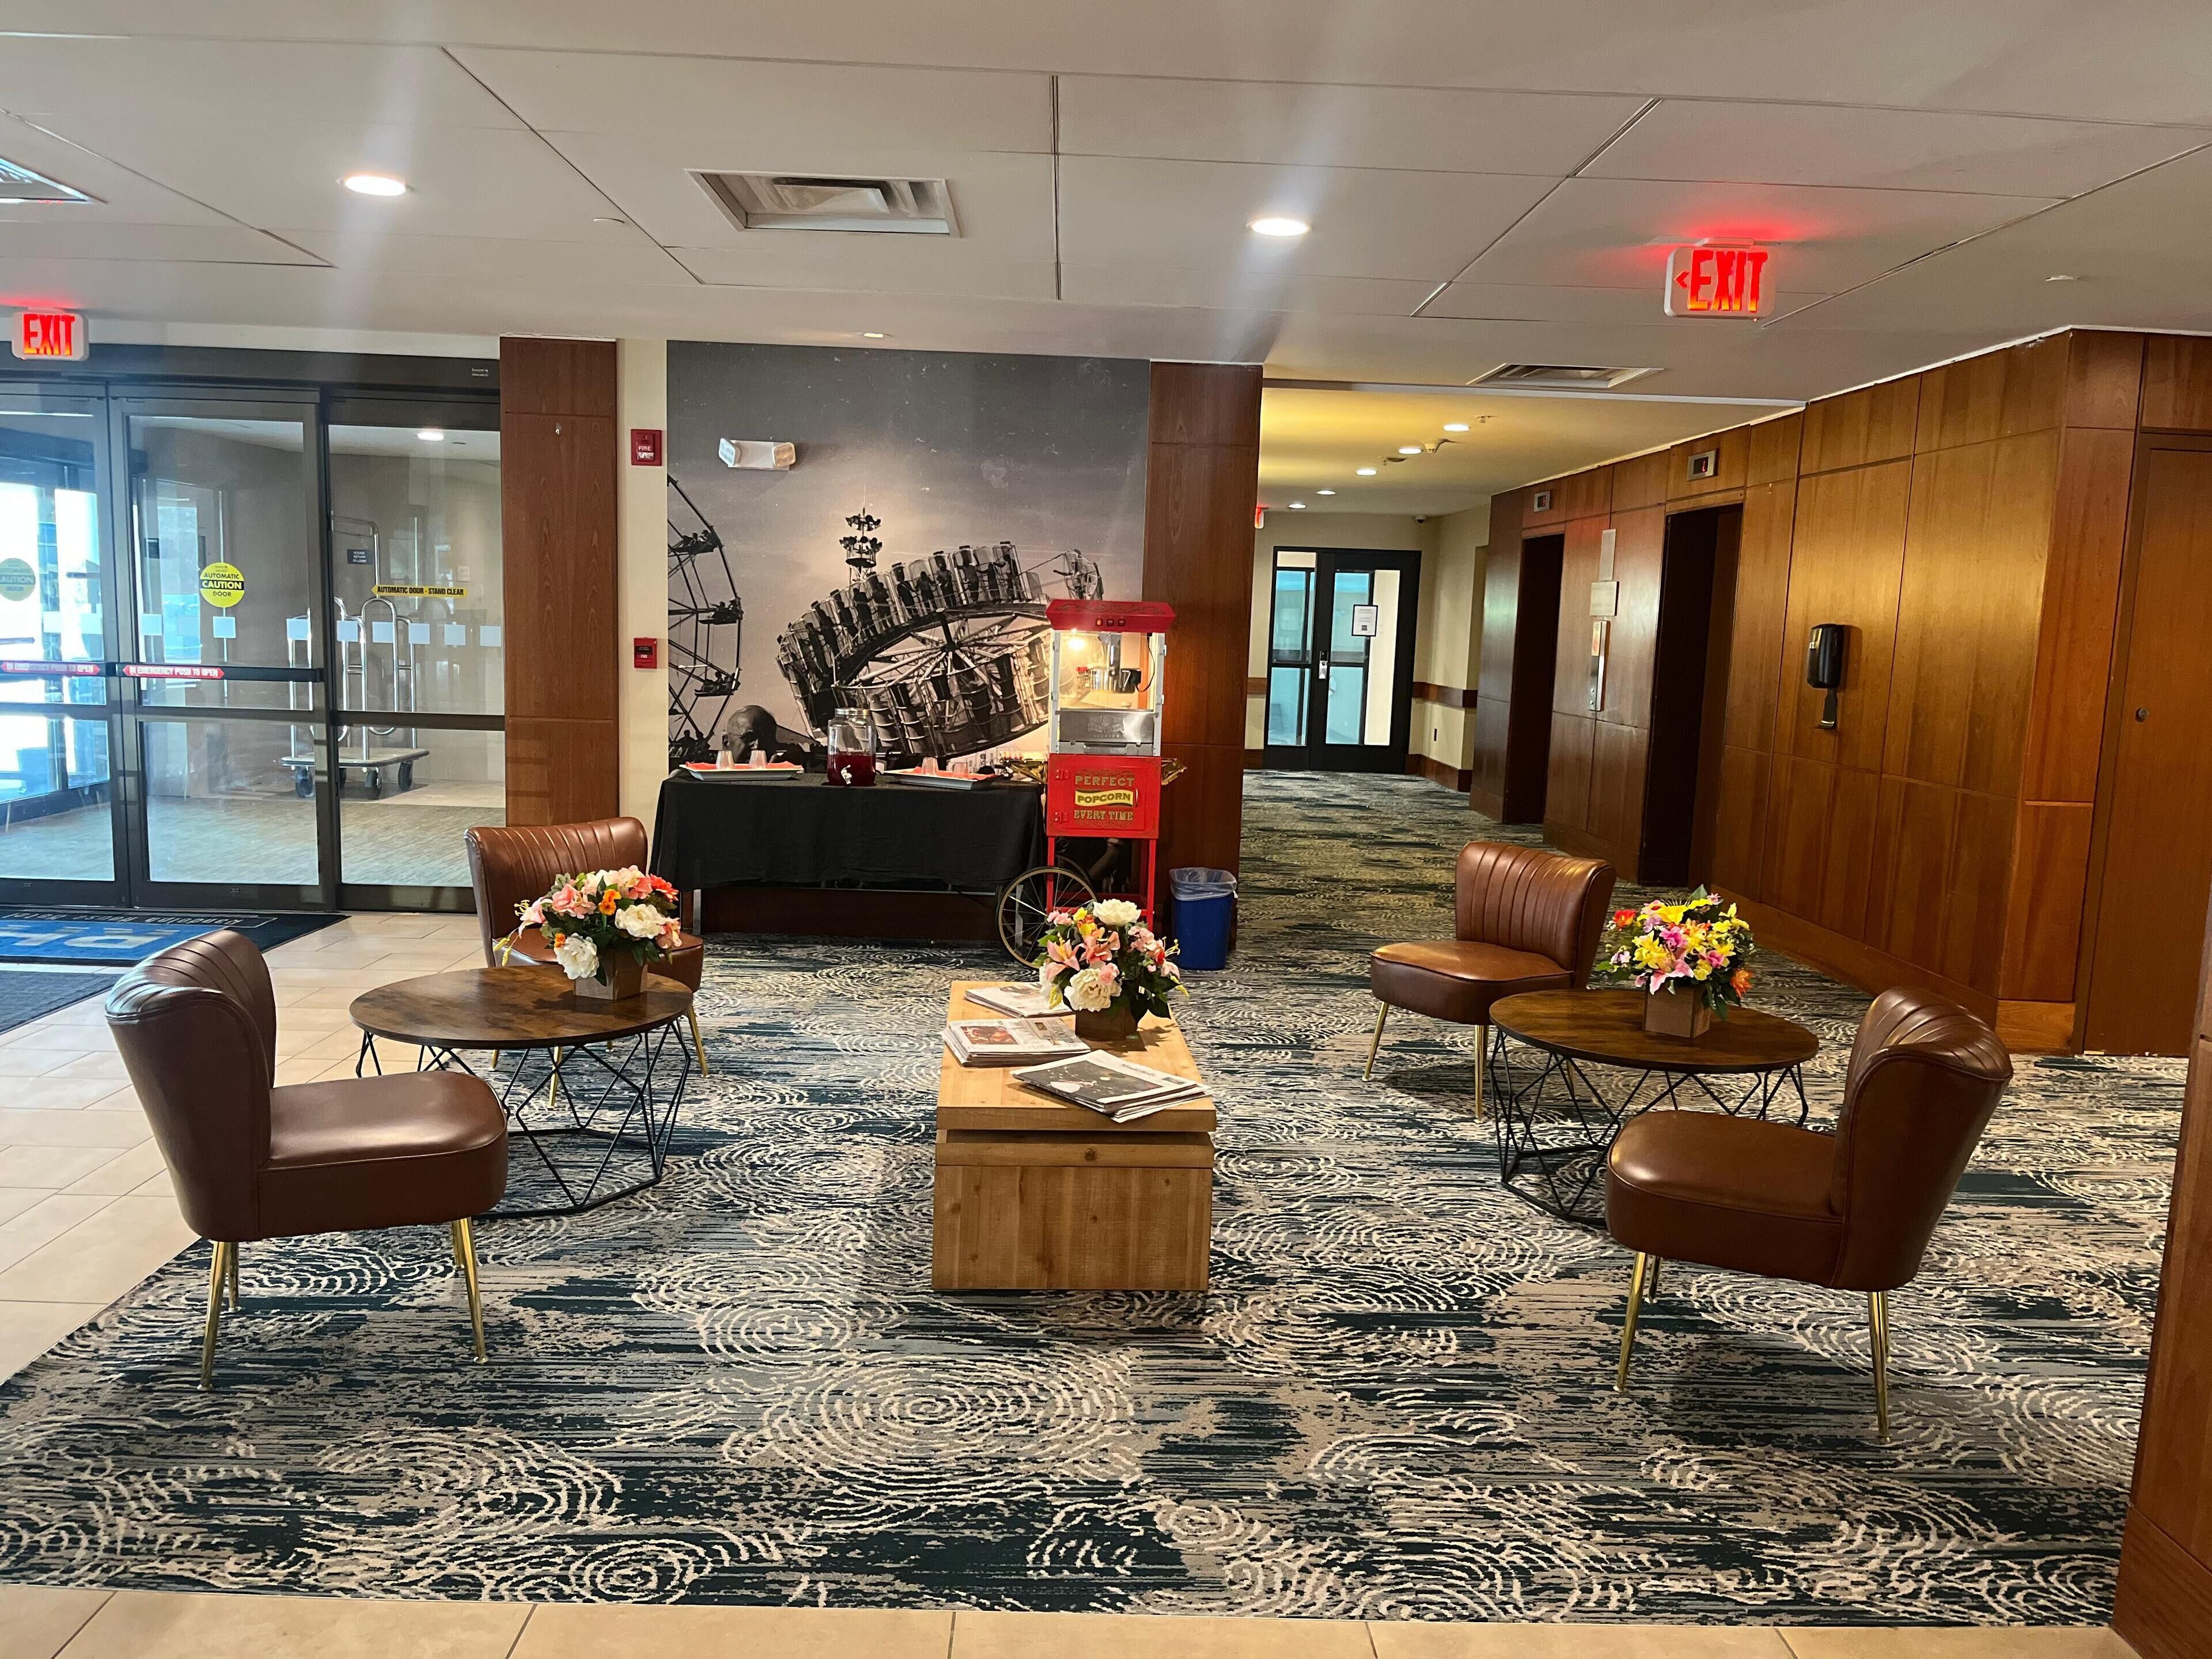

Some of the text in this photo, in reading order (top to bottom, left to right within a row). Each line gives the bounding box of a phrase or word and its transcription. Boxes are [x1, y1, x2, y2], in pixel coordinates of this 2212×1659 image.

[1687, 249, 1768, 313] EXIT
[23, 313, 75, 356] EXIT
[0, 575, 33, 584] AUTION
[202, 580, 242, 589] CAUTION
[137, 666, 173, 675] EMERGENCY
[175, 667, 191, 676] PUSH
[192, 668, 200, 676] TO
[202, 668, 218, 677] OPEN
[1075, 775, 1134, 786] PERFECT
[1077, 793, 1131, 803] POPCORN
[1073, 810, 1133, 821] EVERY TIME
[144, 917, 244, 925] Randolph
